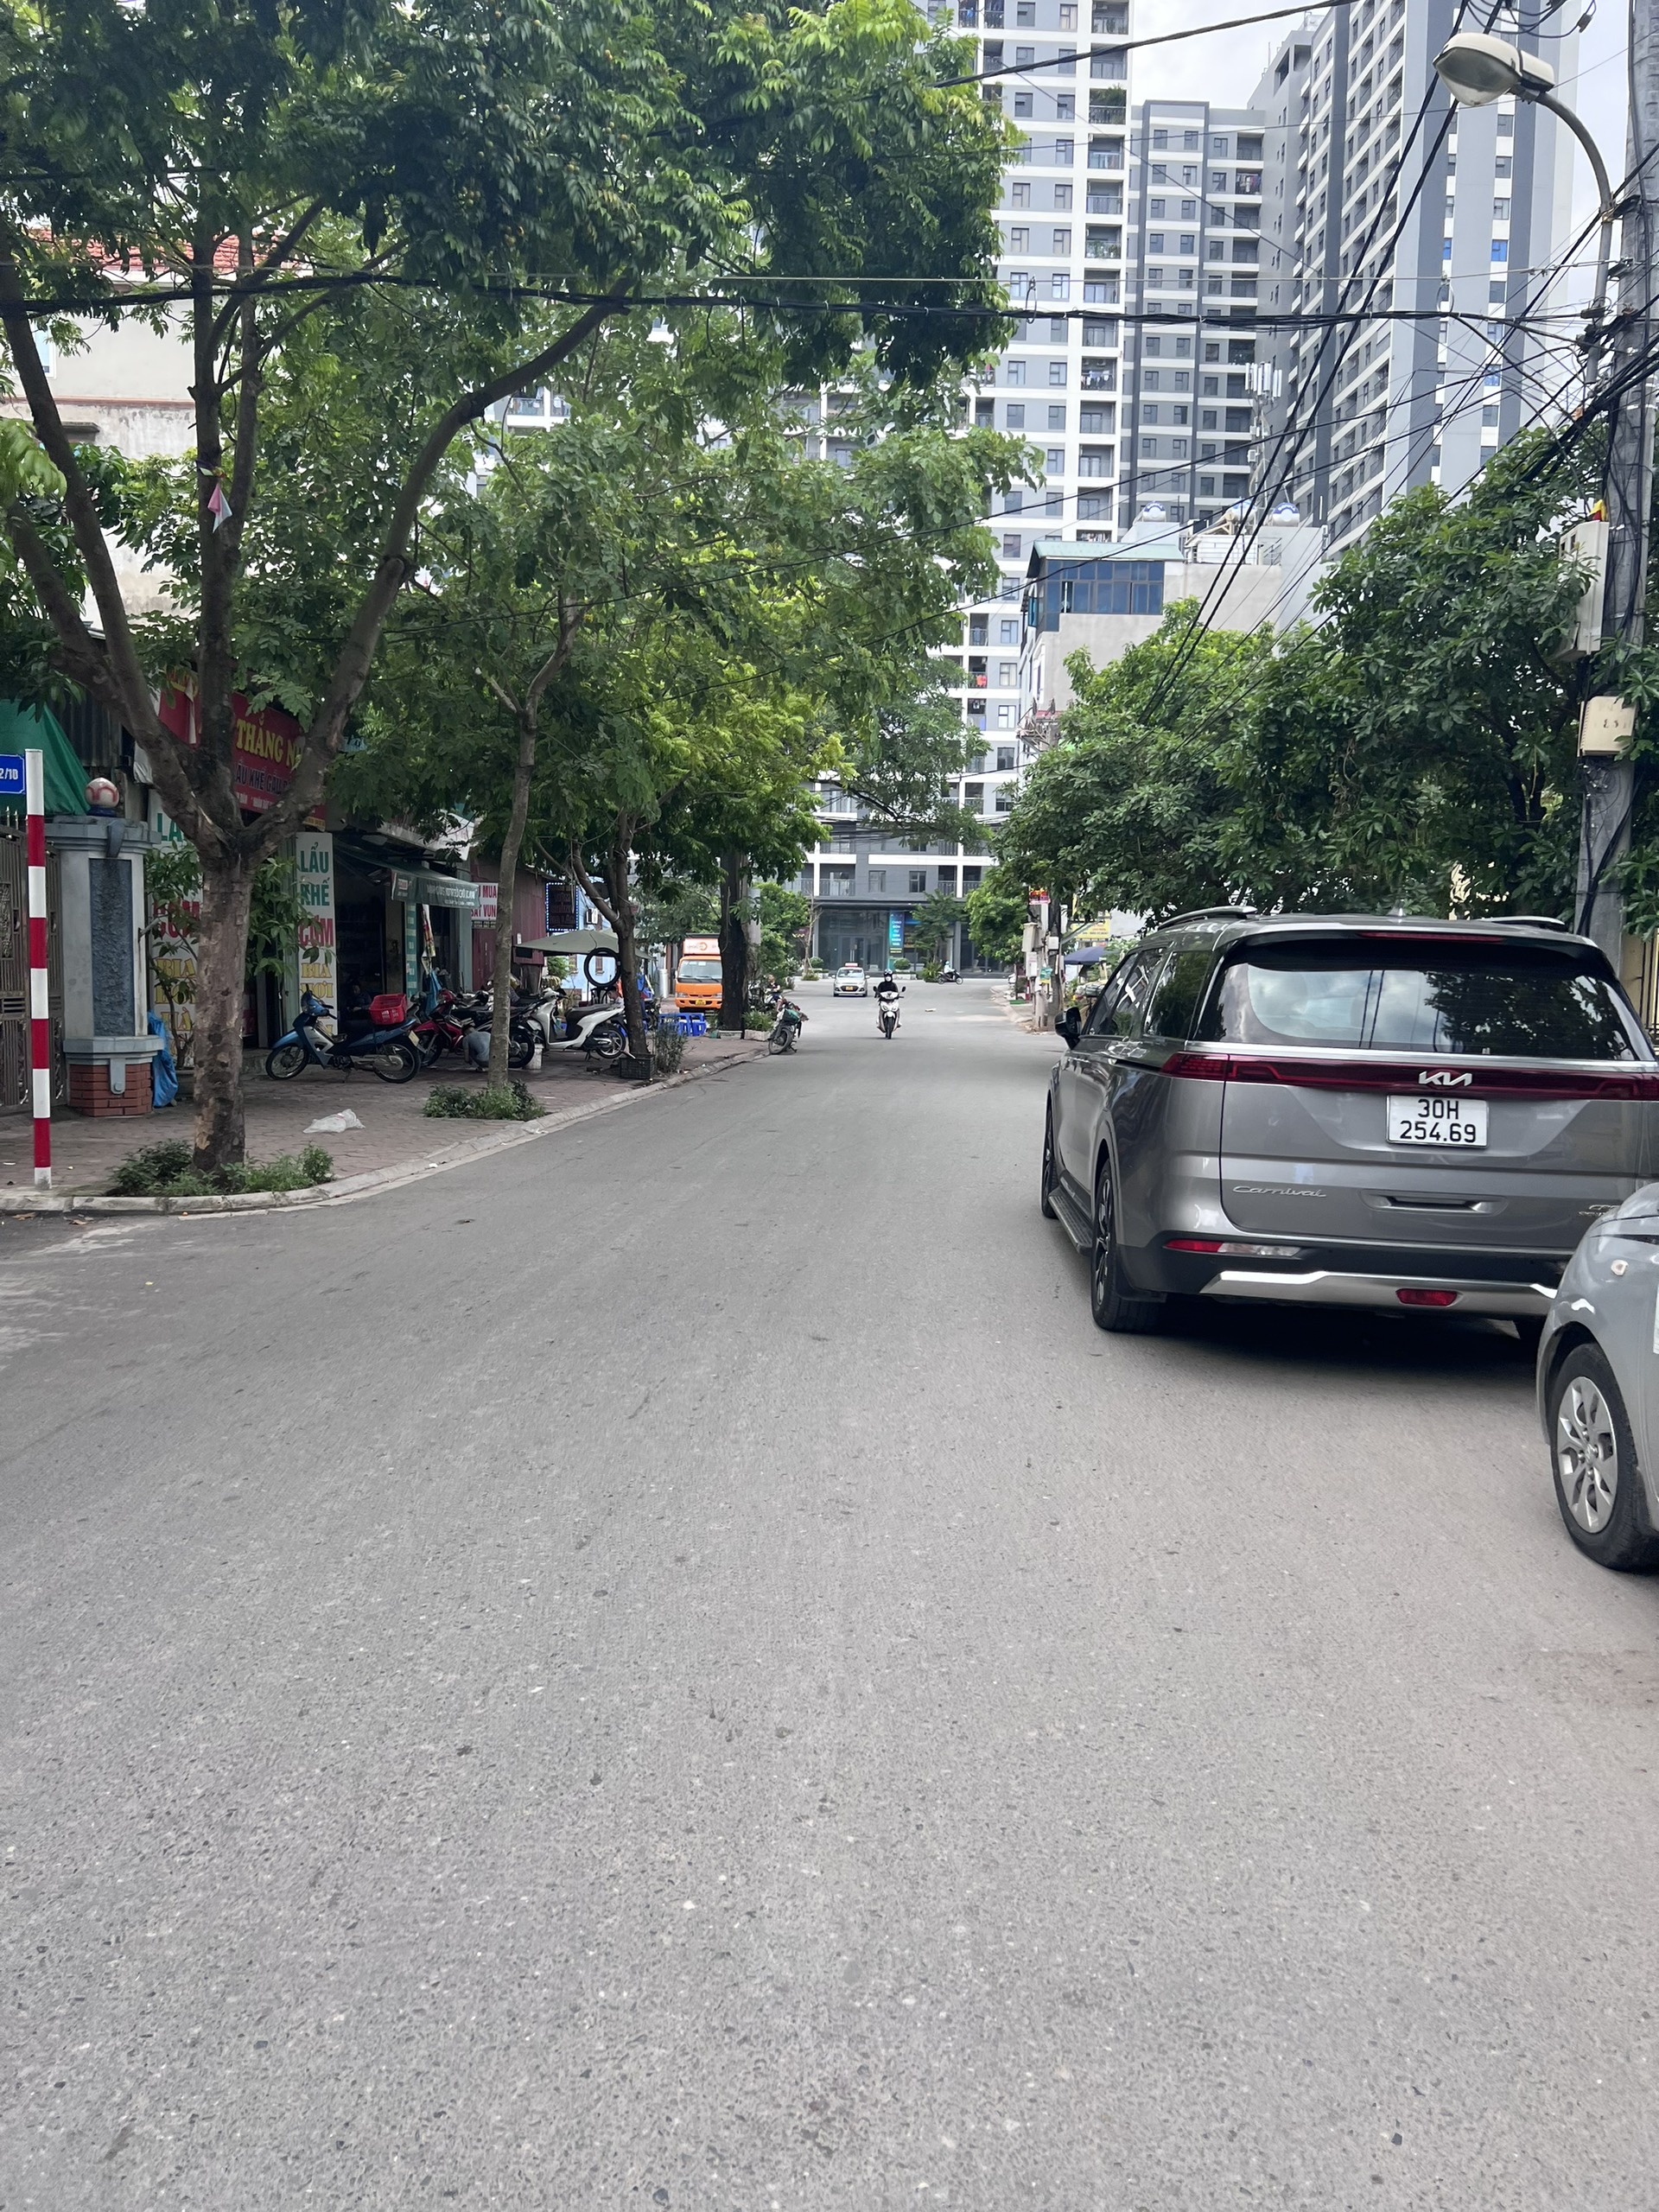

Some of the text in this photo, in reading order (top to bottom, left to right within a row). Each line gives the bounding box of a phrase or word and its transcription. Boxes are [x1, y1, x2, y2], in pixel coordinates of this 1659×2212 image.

[300, 842, 328, 874] LẨU
[300, 877, 330, 906] KHẾ
[482, 885, 497, 899] MUA
[156, 957, 196, 978] BIA
[301, 963, 332, 978] BIA
[1418, 1071, 1472, 1086] KIA
[1418, 1098, 1459, 1120] 30H
[1400, 1120, 1476, 1142] 254.69
[1232, 1185, 1326, 1197] Carnival
